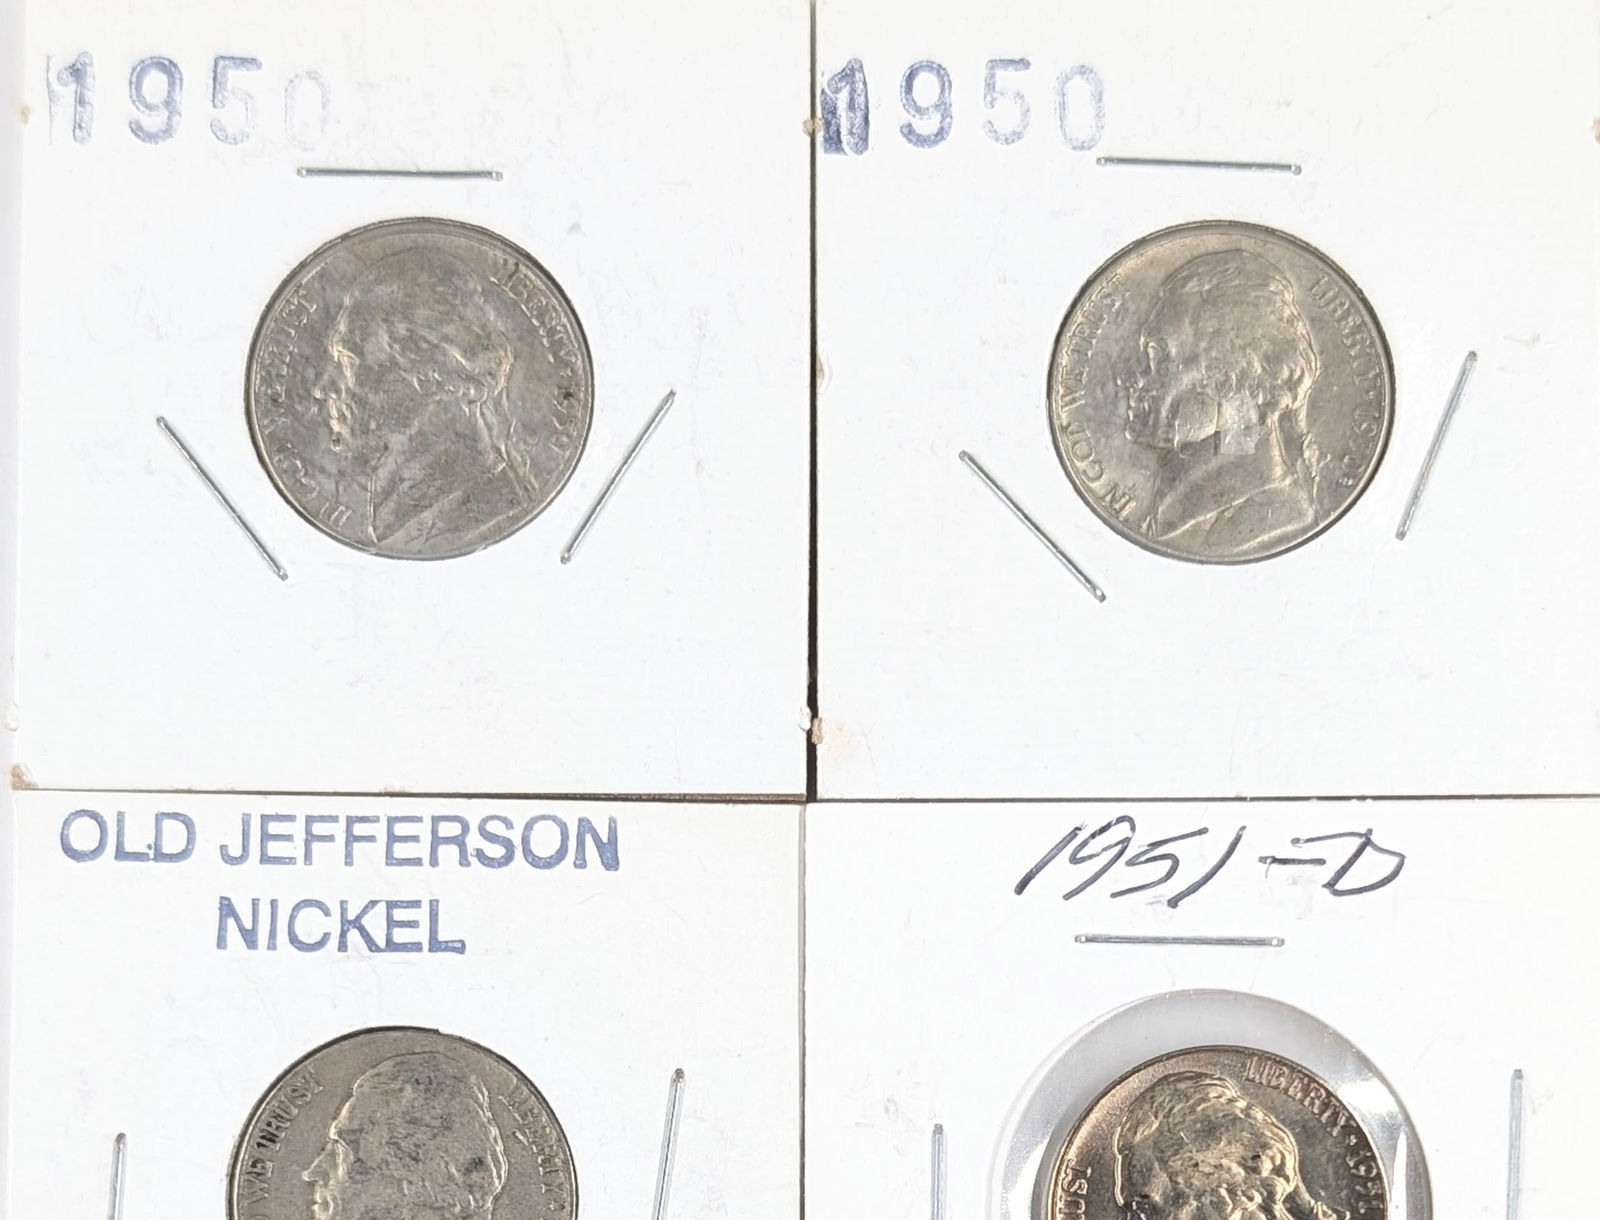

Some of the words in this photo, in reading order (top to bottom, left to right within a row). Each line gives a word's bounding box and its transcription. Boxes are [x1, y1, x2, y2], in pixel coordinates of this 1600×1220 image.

[46, 51, 330, 150] 1950
[820, 57, 1105, 155] 1950
[1309, 273, 1382, 387] LIBERTY
[1063, 419, 1105, 486] GOD
[1100, 483, 1137, 524] IN
[60, 809, 197, 864] OLD
[219, 813, 621, 871] JEFFERSON
[216, 896, 466, 955] NICKEL
[1243, 1055, 1358, 1138] LIBERTY
